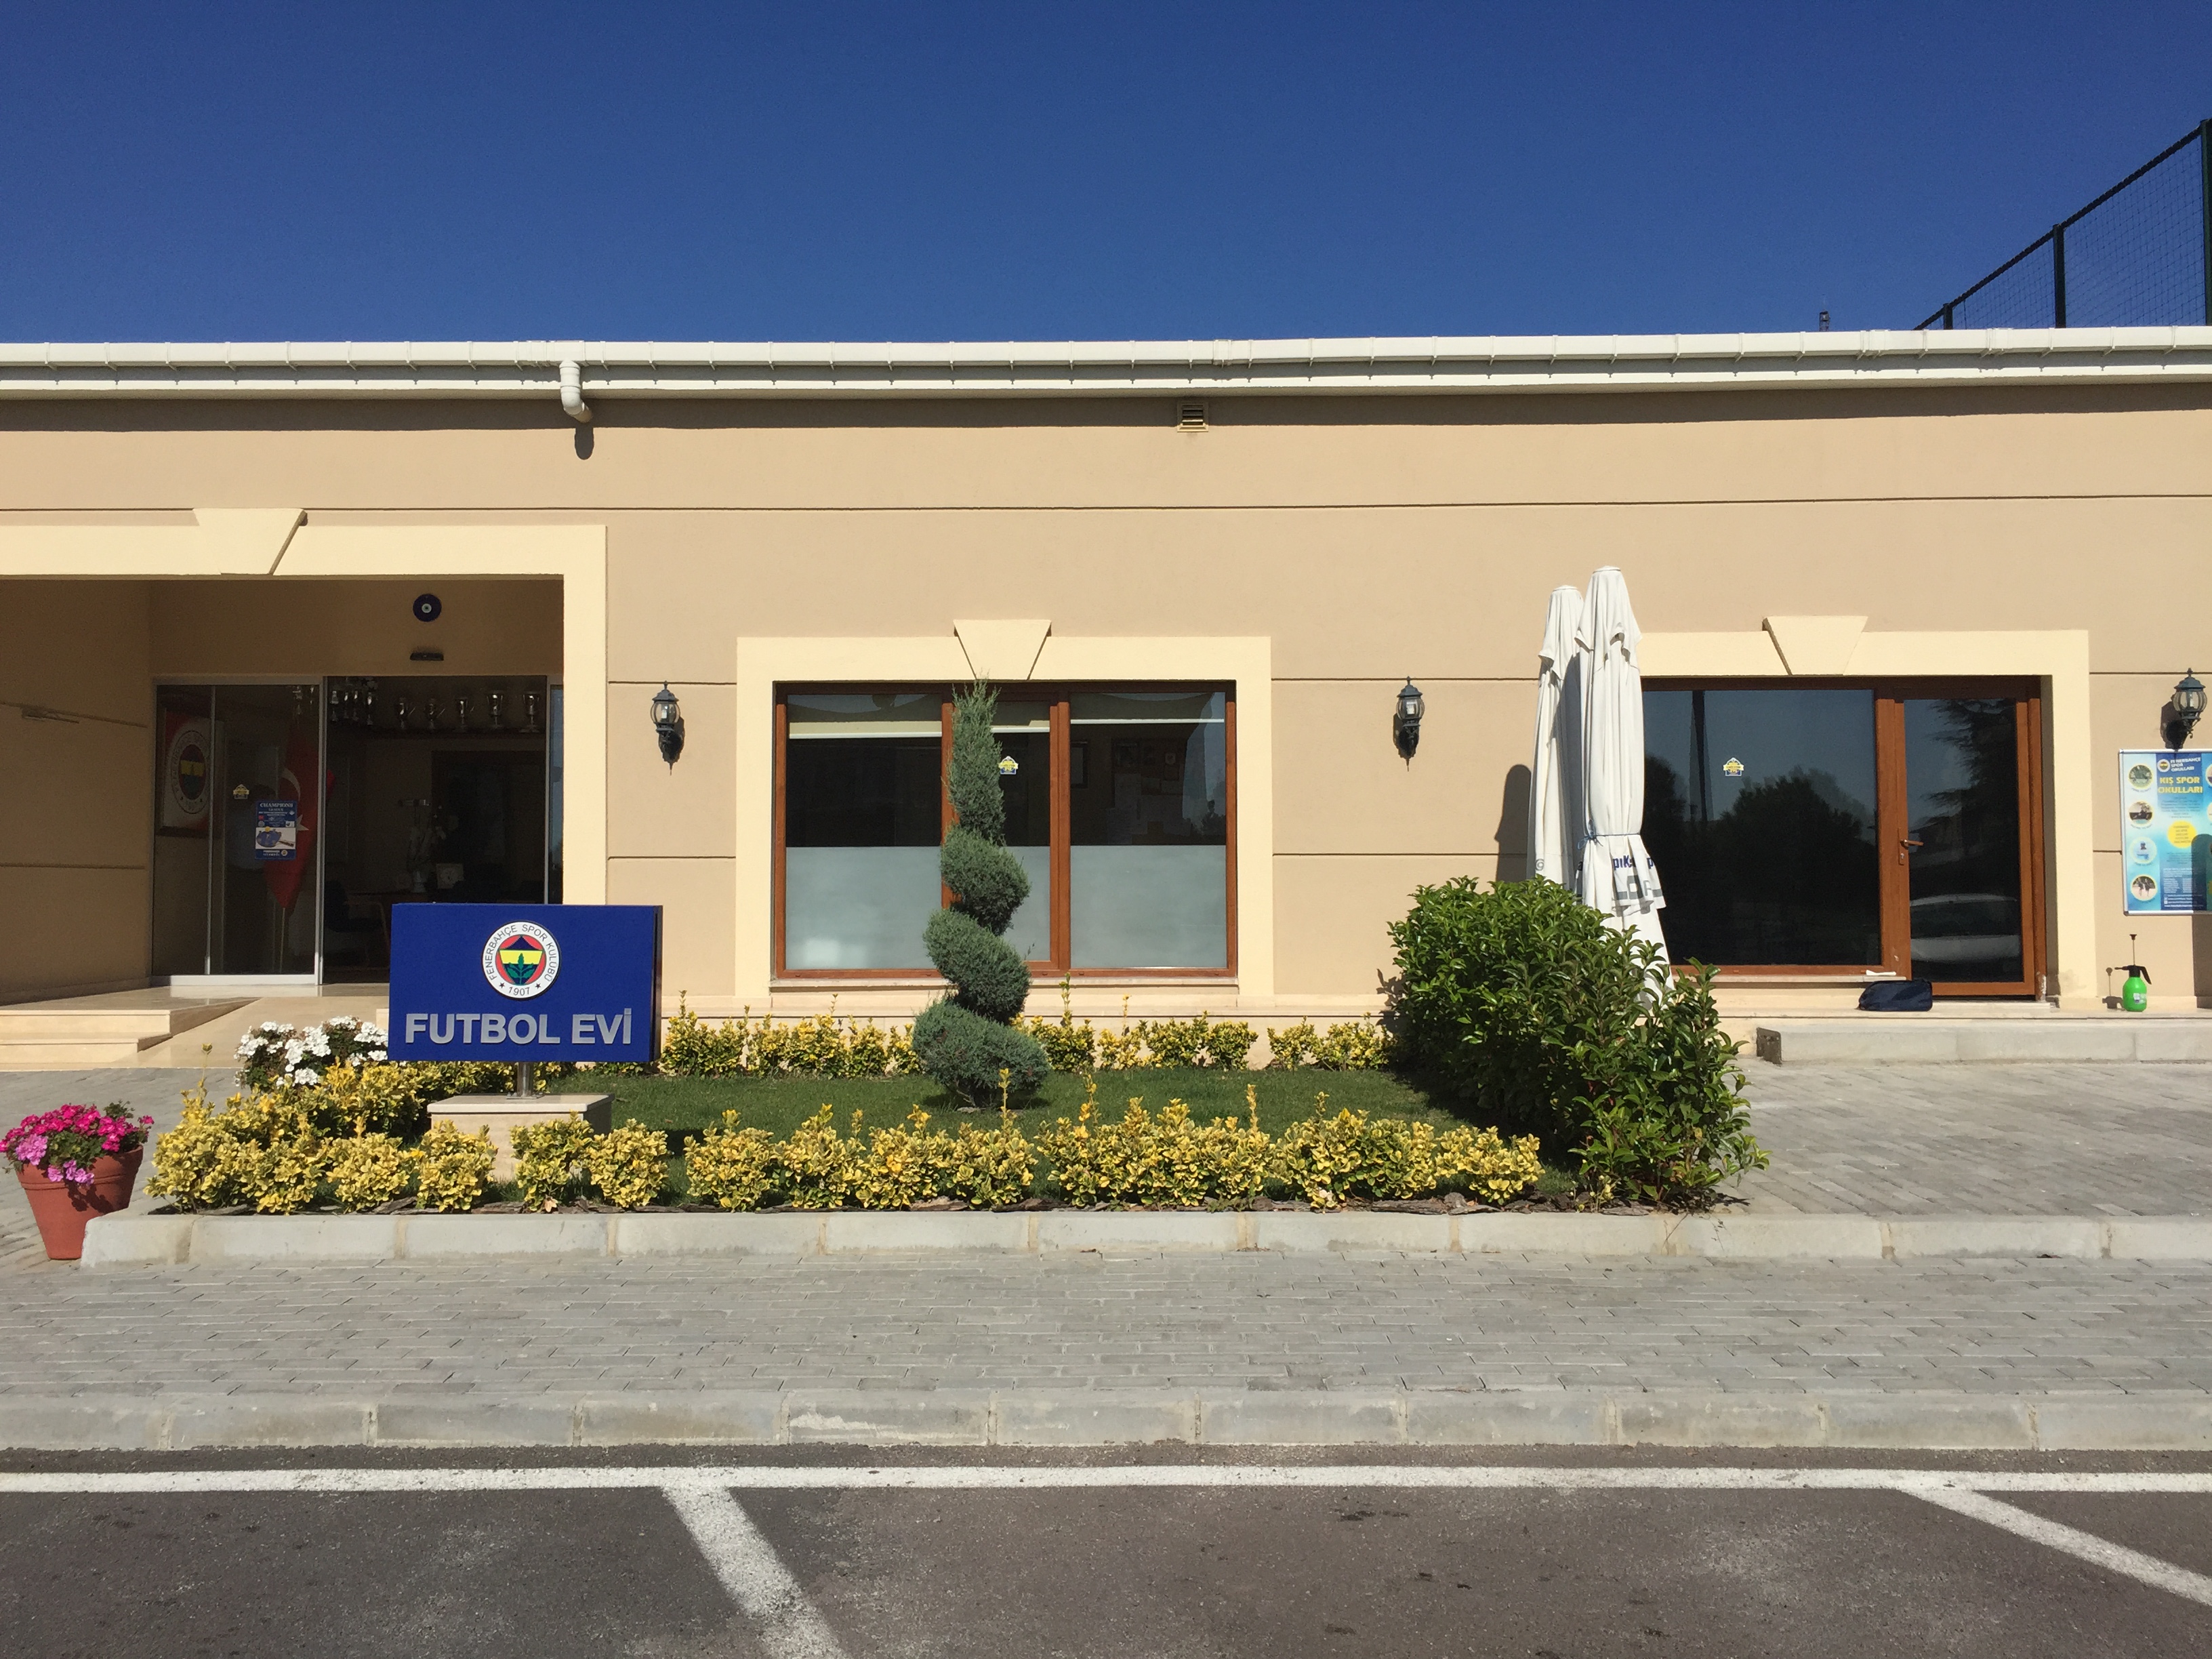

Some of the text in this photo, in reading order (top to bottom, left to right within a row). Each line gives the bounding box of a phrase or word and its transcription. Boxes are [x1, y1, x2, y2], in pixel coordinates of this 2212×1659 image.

[2159, 777, 2174, 785] KIŞ
[485, 924, 558, 982] FENERBAHÇE SPOR KULÜBÜ
[508, 987, 530, 996] 1907
[405, 1008, 632, 1044] FUTBOL EVİ
